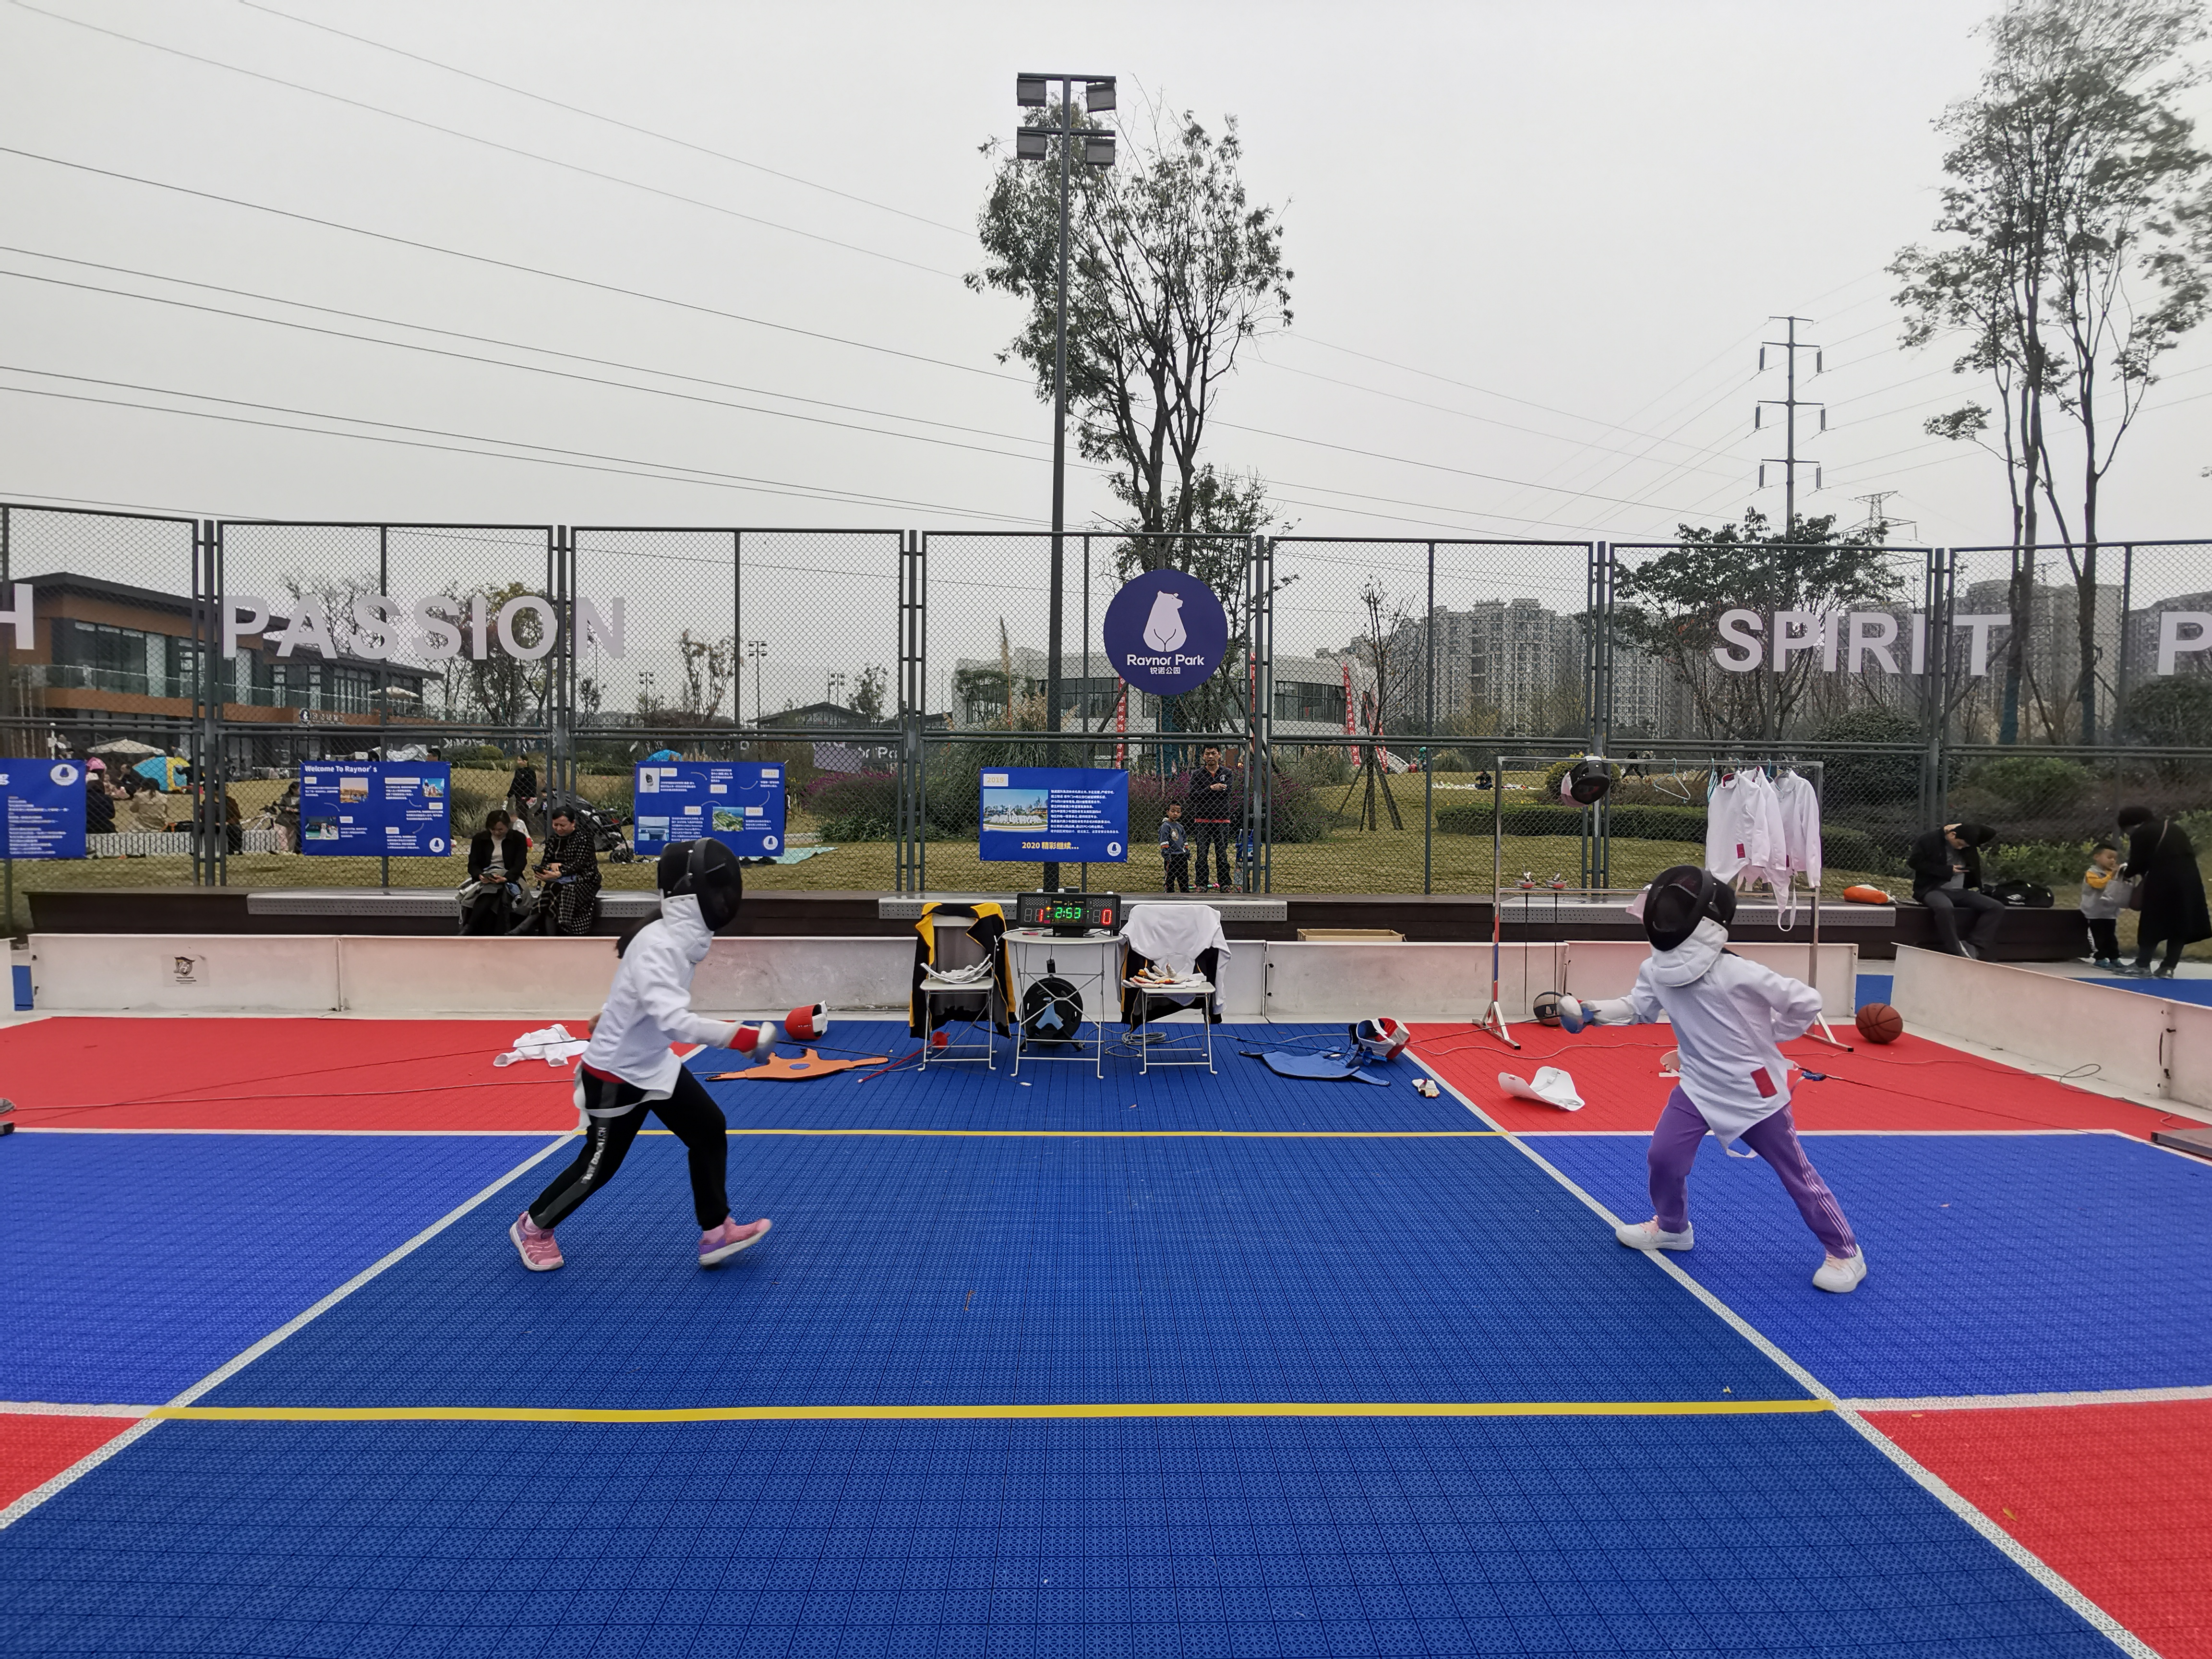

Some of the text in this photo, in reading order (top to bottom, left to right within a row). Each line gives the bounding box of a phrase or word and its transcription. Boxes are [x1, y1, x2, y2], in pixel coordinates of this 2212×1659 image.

[223, 595, 625, 660] PASSION
[1714, 609, 2011, 676] SPIRIT
[1127, 654, 1205, 666] Raynor Park
[1055, 907, 1081, 919] 2:53
[1103, 909, 1112, 925] 0
